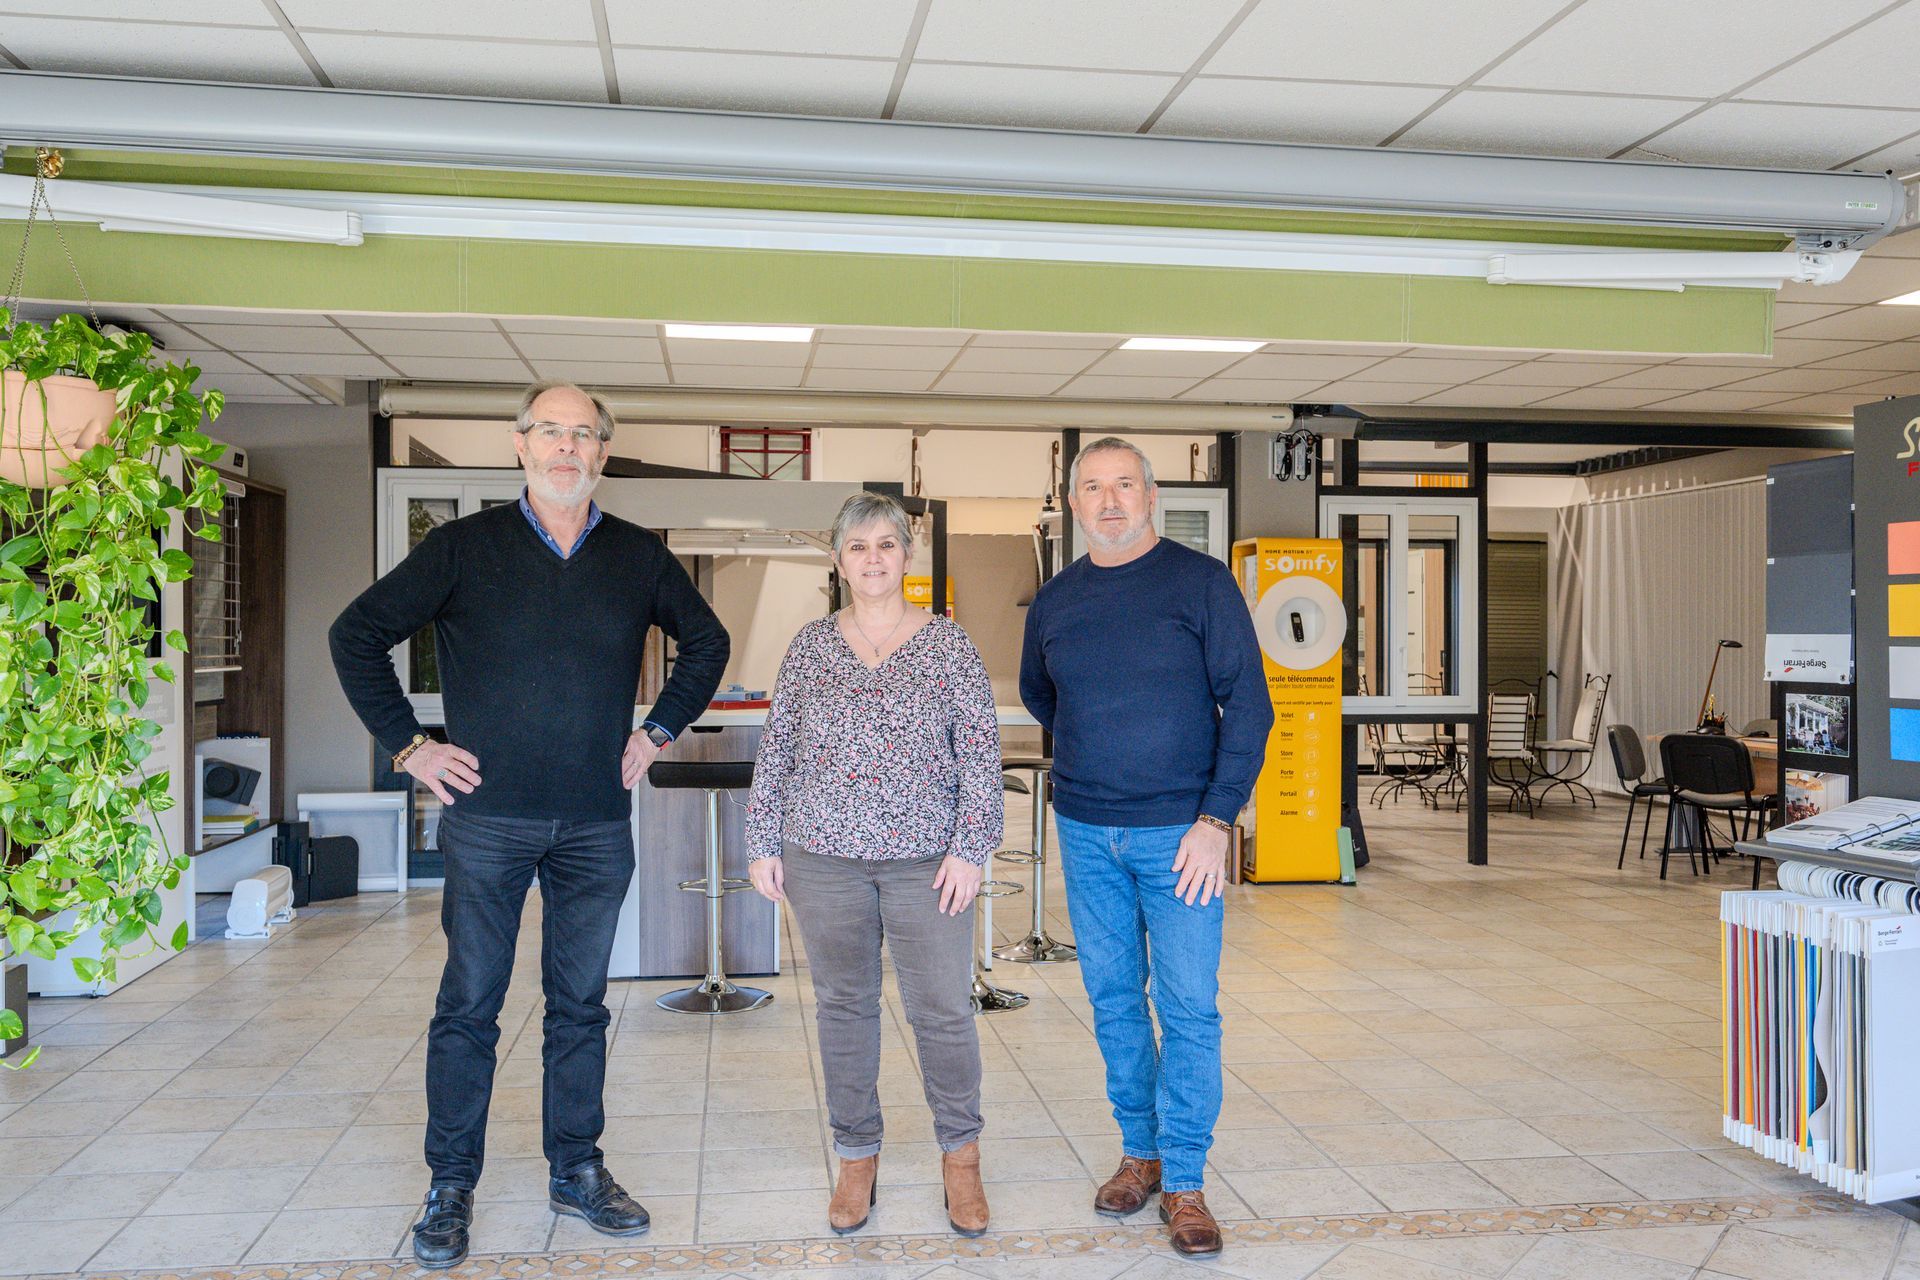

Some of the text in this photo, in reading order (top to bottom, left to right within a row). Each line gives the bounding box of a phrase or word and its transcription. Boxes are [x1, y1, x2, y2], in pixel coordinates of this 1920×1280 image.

[1896, 416, 1920, 459] S
[1264, 554, 1338, 575] somfy
[1269, 674, 1335, 683] seule télécommande
